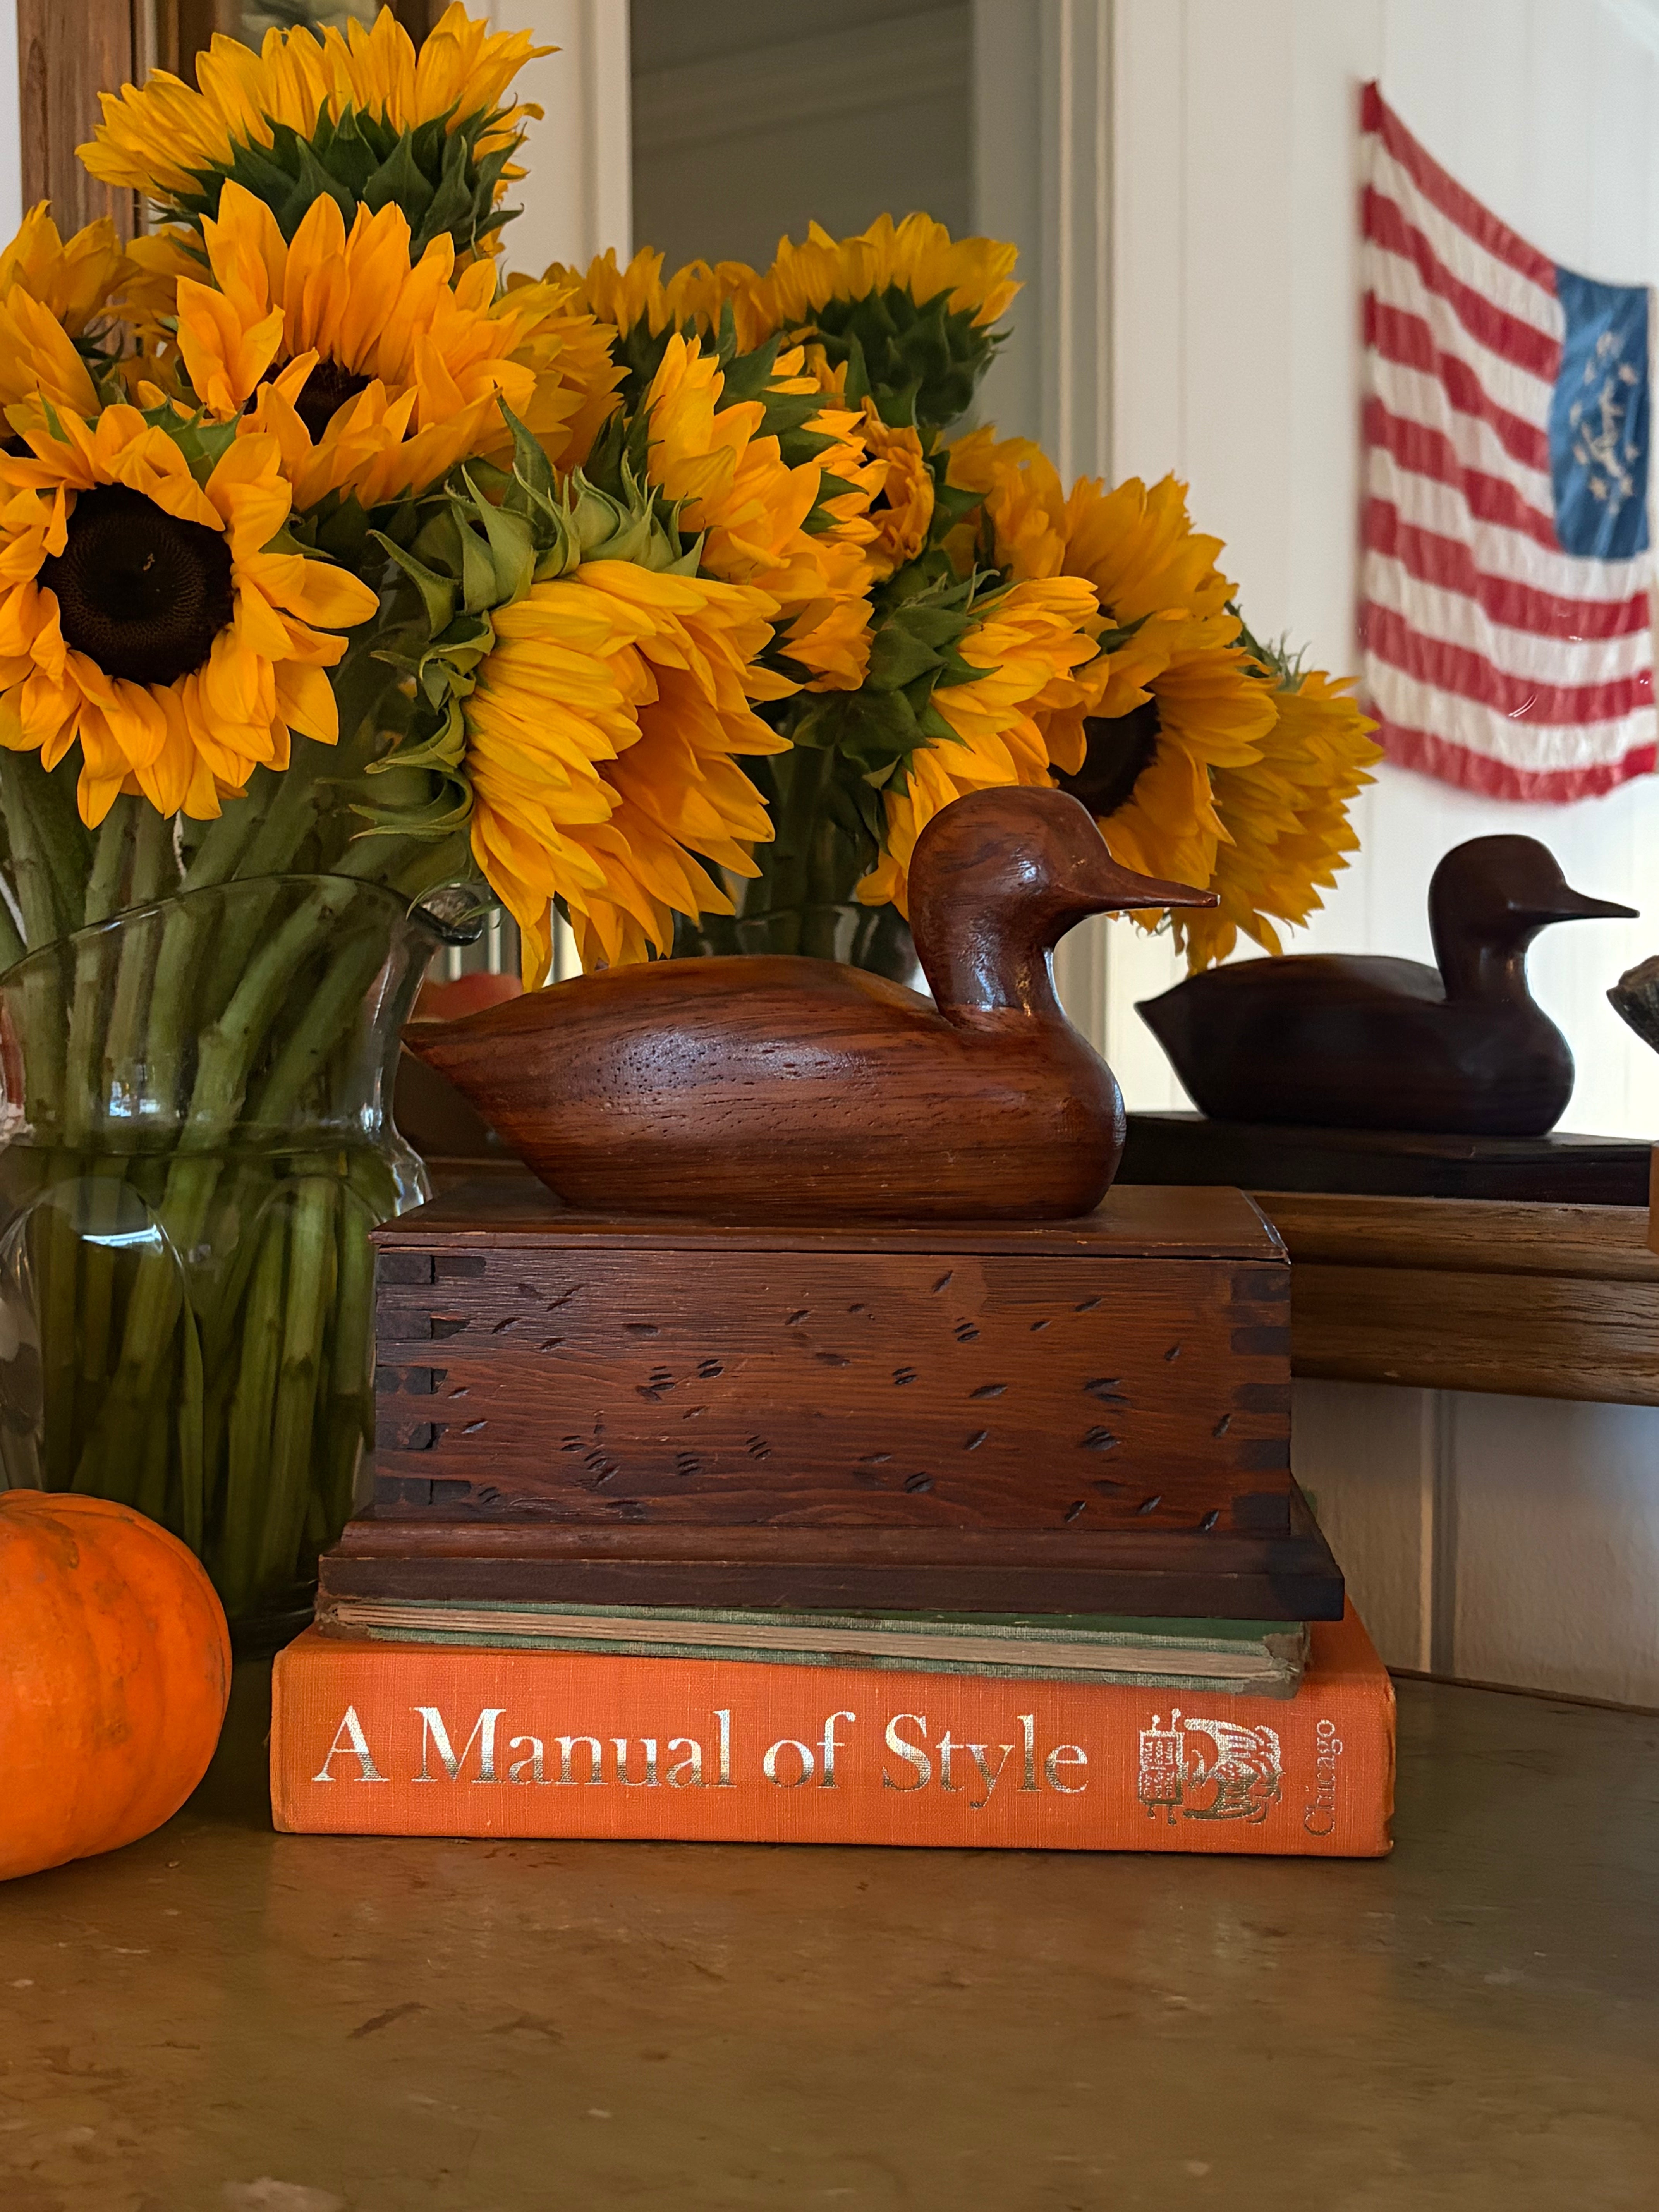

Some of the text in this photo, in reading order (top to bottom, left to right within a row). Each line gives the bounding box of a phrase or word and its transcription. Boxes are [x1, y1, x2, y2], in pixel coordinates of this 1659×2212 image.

[311, 1705, 1088, 1809] A Manual of Style
[1304, 1719, 1343, 1836] Chicago
